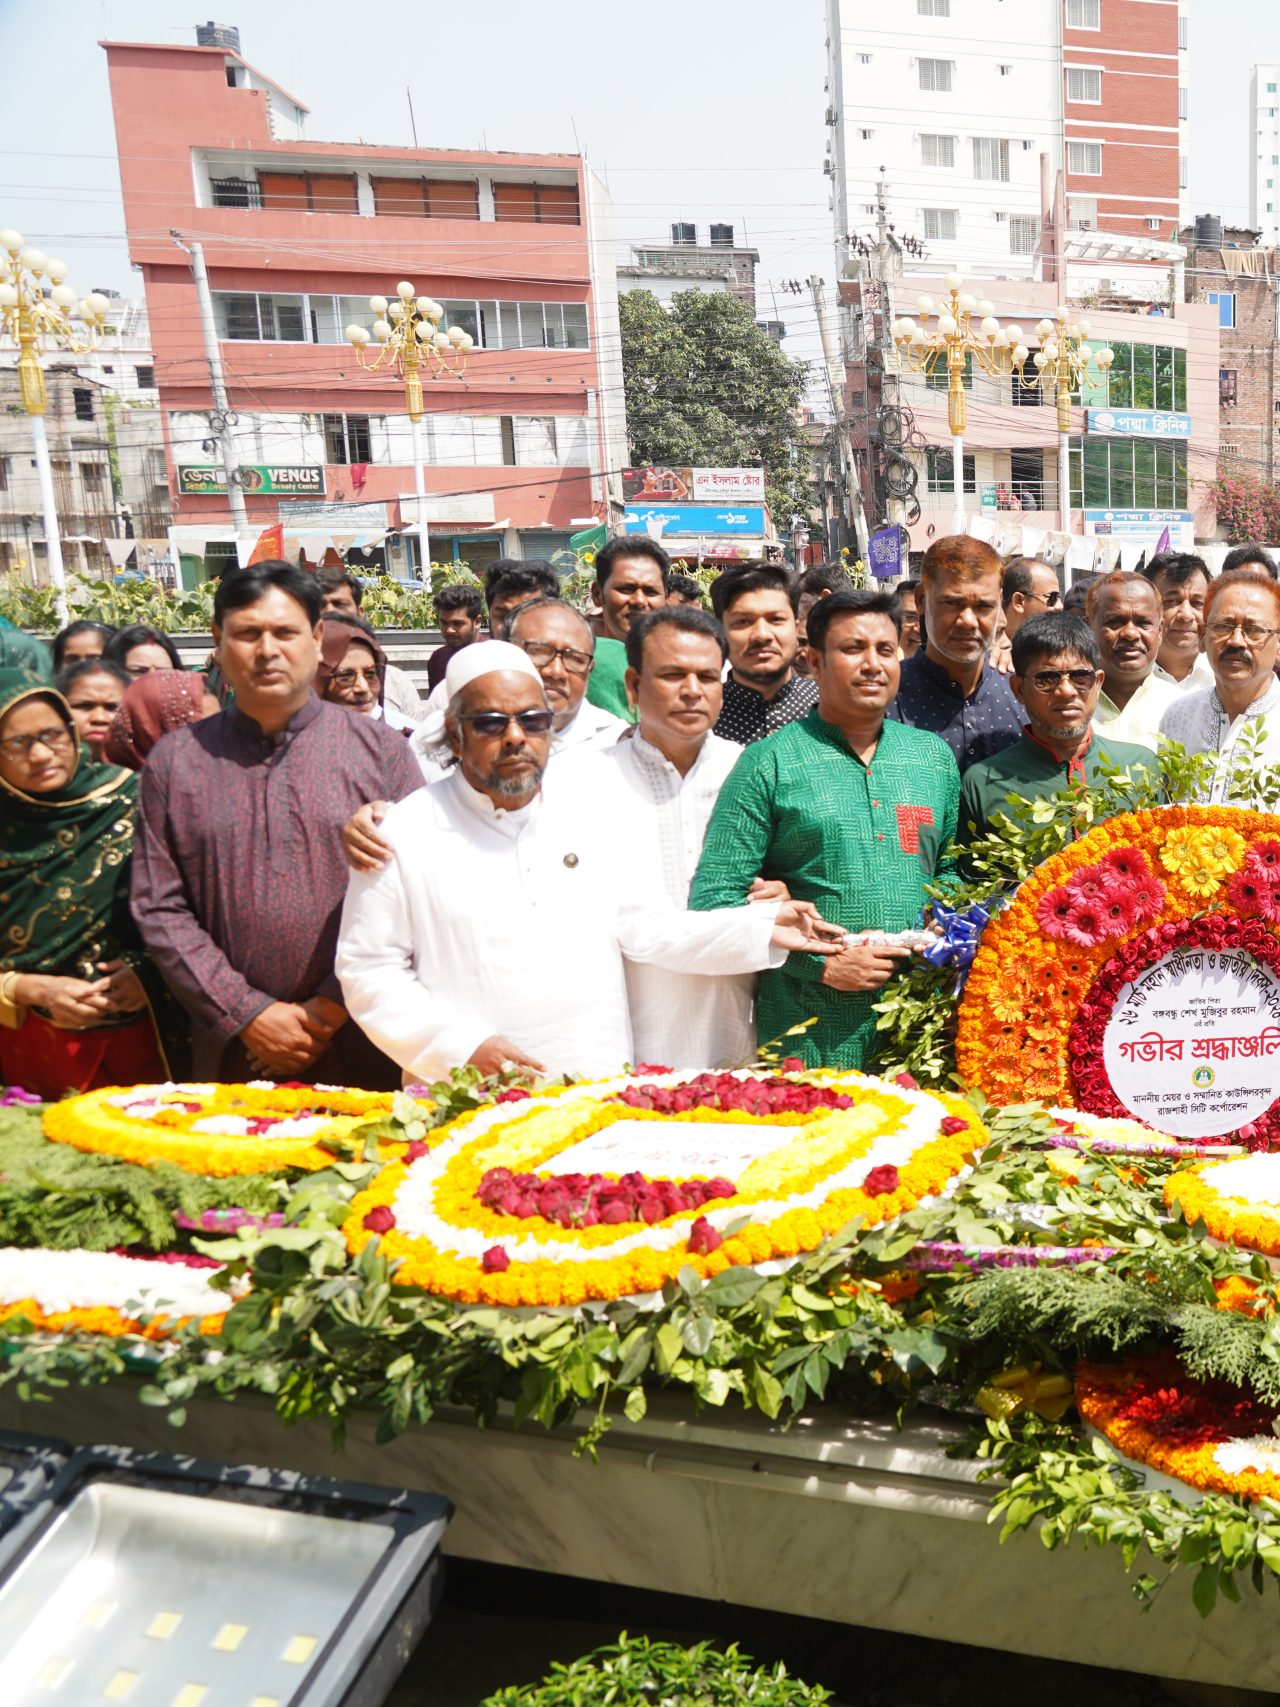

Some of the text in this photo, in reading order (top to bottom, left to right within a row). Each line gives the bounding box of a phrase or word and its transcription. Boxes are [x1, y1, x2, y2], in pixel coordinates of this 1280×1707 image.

[1152, 415, 1189, 433] ক্লিনিক
[268, 469, 320, 482] VENUS
[712, 474, 739, 486] ইসলাম
[271, 483, 296, 491] Beauty
[1163, 951, 1205, 978] স্বাধীনতা
[1208, 954, 1216, 969] ও
[1220, 951, 1251, 979] জাতীয়
[1139, 967, 1168, 991] মহান
[1126, 982, 1147, 1007] মার্চ
[1119, 1010, 1139, 1025] ২৬
[1152, 1006, 1256, 1020] বঙ্গবন্ধু শেখ মুজিবুর রহমান
[1119, 1031, 1184, 1062] গভীর
[1133, 1091, 1160, 1103] মাননীয়
[1162, 1092, 1181, 1102] মেয়র
[1193, 1089, 1222, 1100] সম্মানিত
[1225, 1087, 1272, 1099] কাউন্সিলরবৃন্দ
[1157, 1102, 1247, 1116] রাজশাহী সিটি কর্পোরেশন
